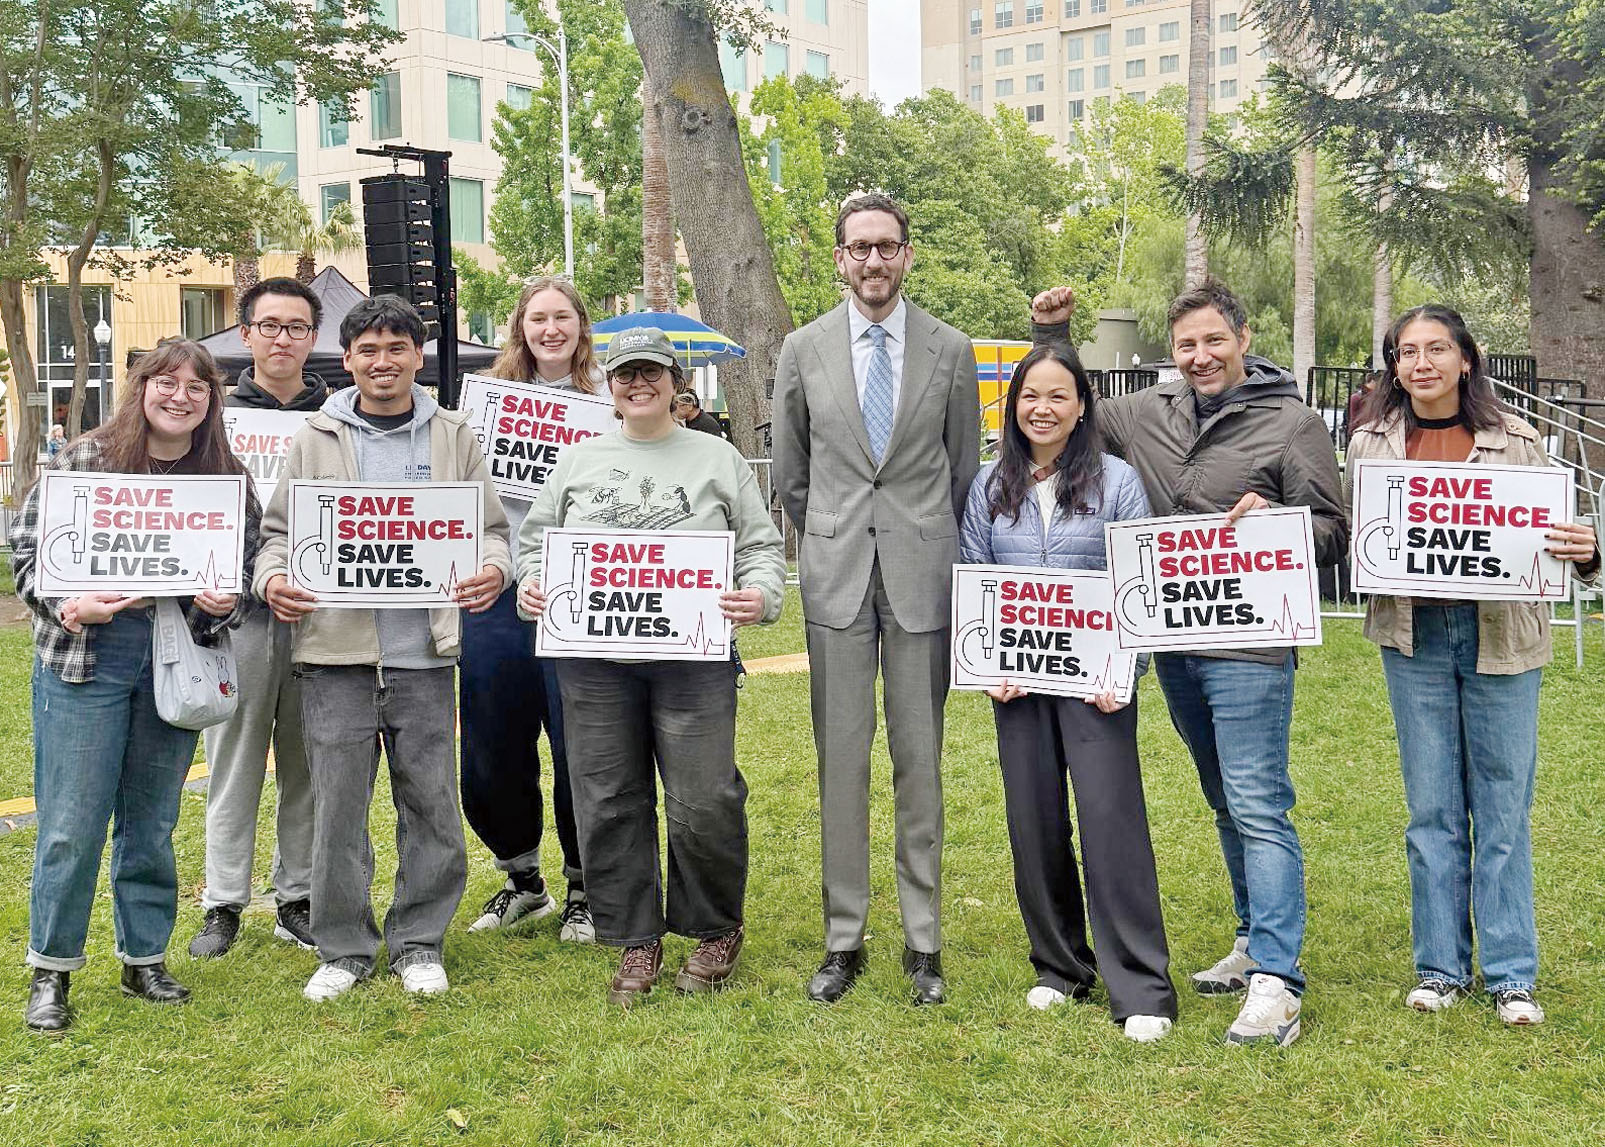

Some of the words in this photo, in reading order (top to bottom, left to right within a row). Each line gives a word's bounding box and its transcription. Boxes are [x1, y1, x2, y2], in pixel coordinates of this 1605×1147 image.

[502, 394, 569, 422] SAVE
[497, 416, 605, 446] SCIENC
[233, 433, 281, 455] SAVE
[493, 437, 560, 465] SAVE
[491, 457, 554, 485] LIVE
[93, 486, 173, 507] SAVE
[1408, 476, 1493, 500] SAVE
[337, 495, 415, 517] SAVE
[92, 509, 234, 530] SCIENCE.
[337, 519, 474, 541] SCIENCE.
[90, 532, 172, 553] SAVE
[1156, 527, 1238, 553] SAVE
[1406, 526, 1492, 553] SAVE
[337, 543, 414, 565] SAVE
[591, 542, 666, 565] SAVE
[1158, 550, 1305, 578] SCIENCE.
[1406, 552, 1511, 579] LIVES.
[90, 555, 189, 577] LIVES.
[337, 567, 432, 588] LIVES.
[589, 566, 723, 589] SCIENCE.
[588, 590, 663, 614] SAVE
[1000, 580, 1074, 605] SAVE
[1161, 577, 1244, 603] SAVE
[587, 615, 679, 638] LIVES.
[1163, 602, 1265, 629] LIVES.
[999, 627, 1073, 652] SAVE
[999, 651, 1089, 678] LIVES.
